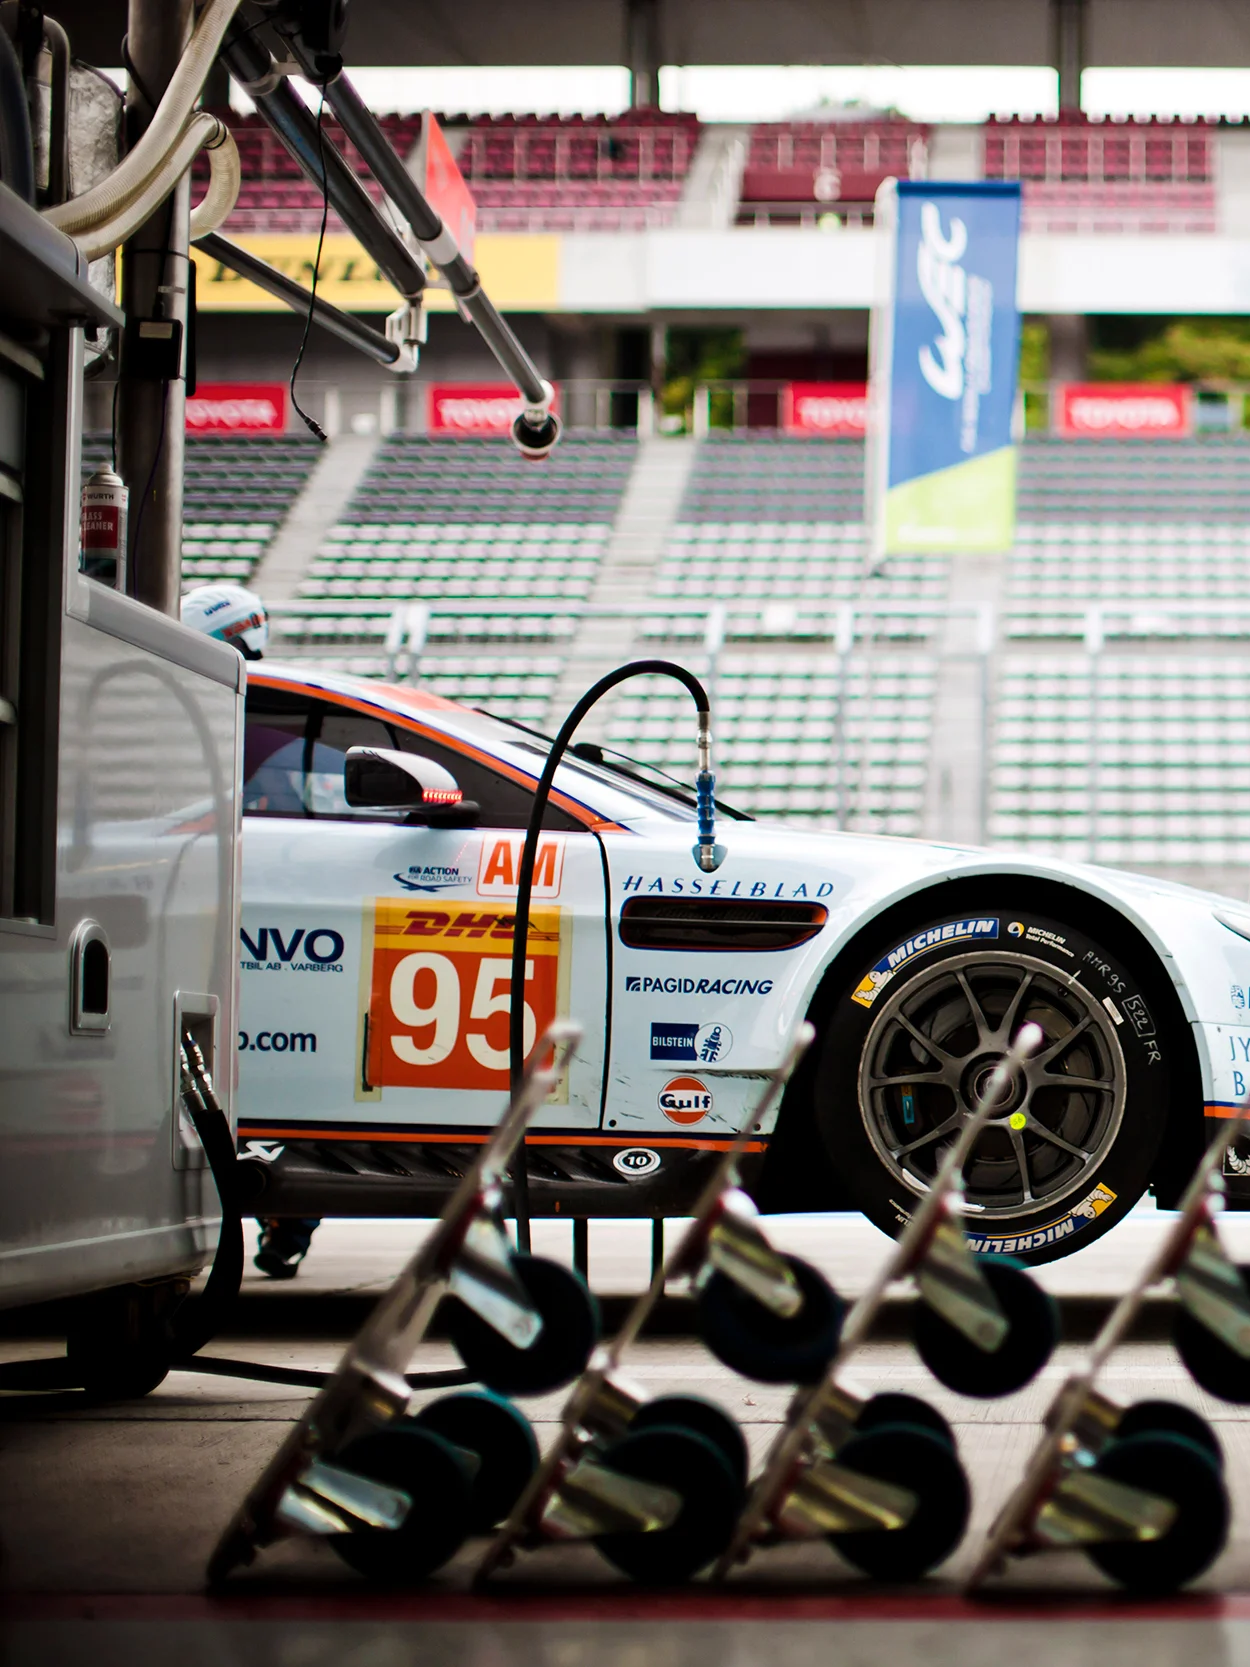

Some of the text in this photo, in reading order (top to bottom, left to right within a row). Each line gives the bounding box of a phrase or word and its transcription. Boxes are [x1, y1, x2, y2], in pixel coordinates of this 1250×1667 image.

[422, 867, 460, 876] ACTION
[483, 839, 560, 889] AM
[420, 875, 442, 883] ROAD
[443, 875, 473, 884] SAFETY
[622, 875, 834, 898] HASSELBLAD
[887, 920, 995, 969] MICHELIN
[1027, 926, 1067, 945] MICHELIN
[265, 962, 282, 971] AB
[290, 962, 344, 973] VARBERG
[389, 951, 537, 1071] 95
[652, 1036, 694, 1049] BILSTEIN
[659, 1093, 711, 1110] Gulf
[627, 1155, 648, 1167] 10
[965, 1218, 1076, 1254] MICHELIN
